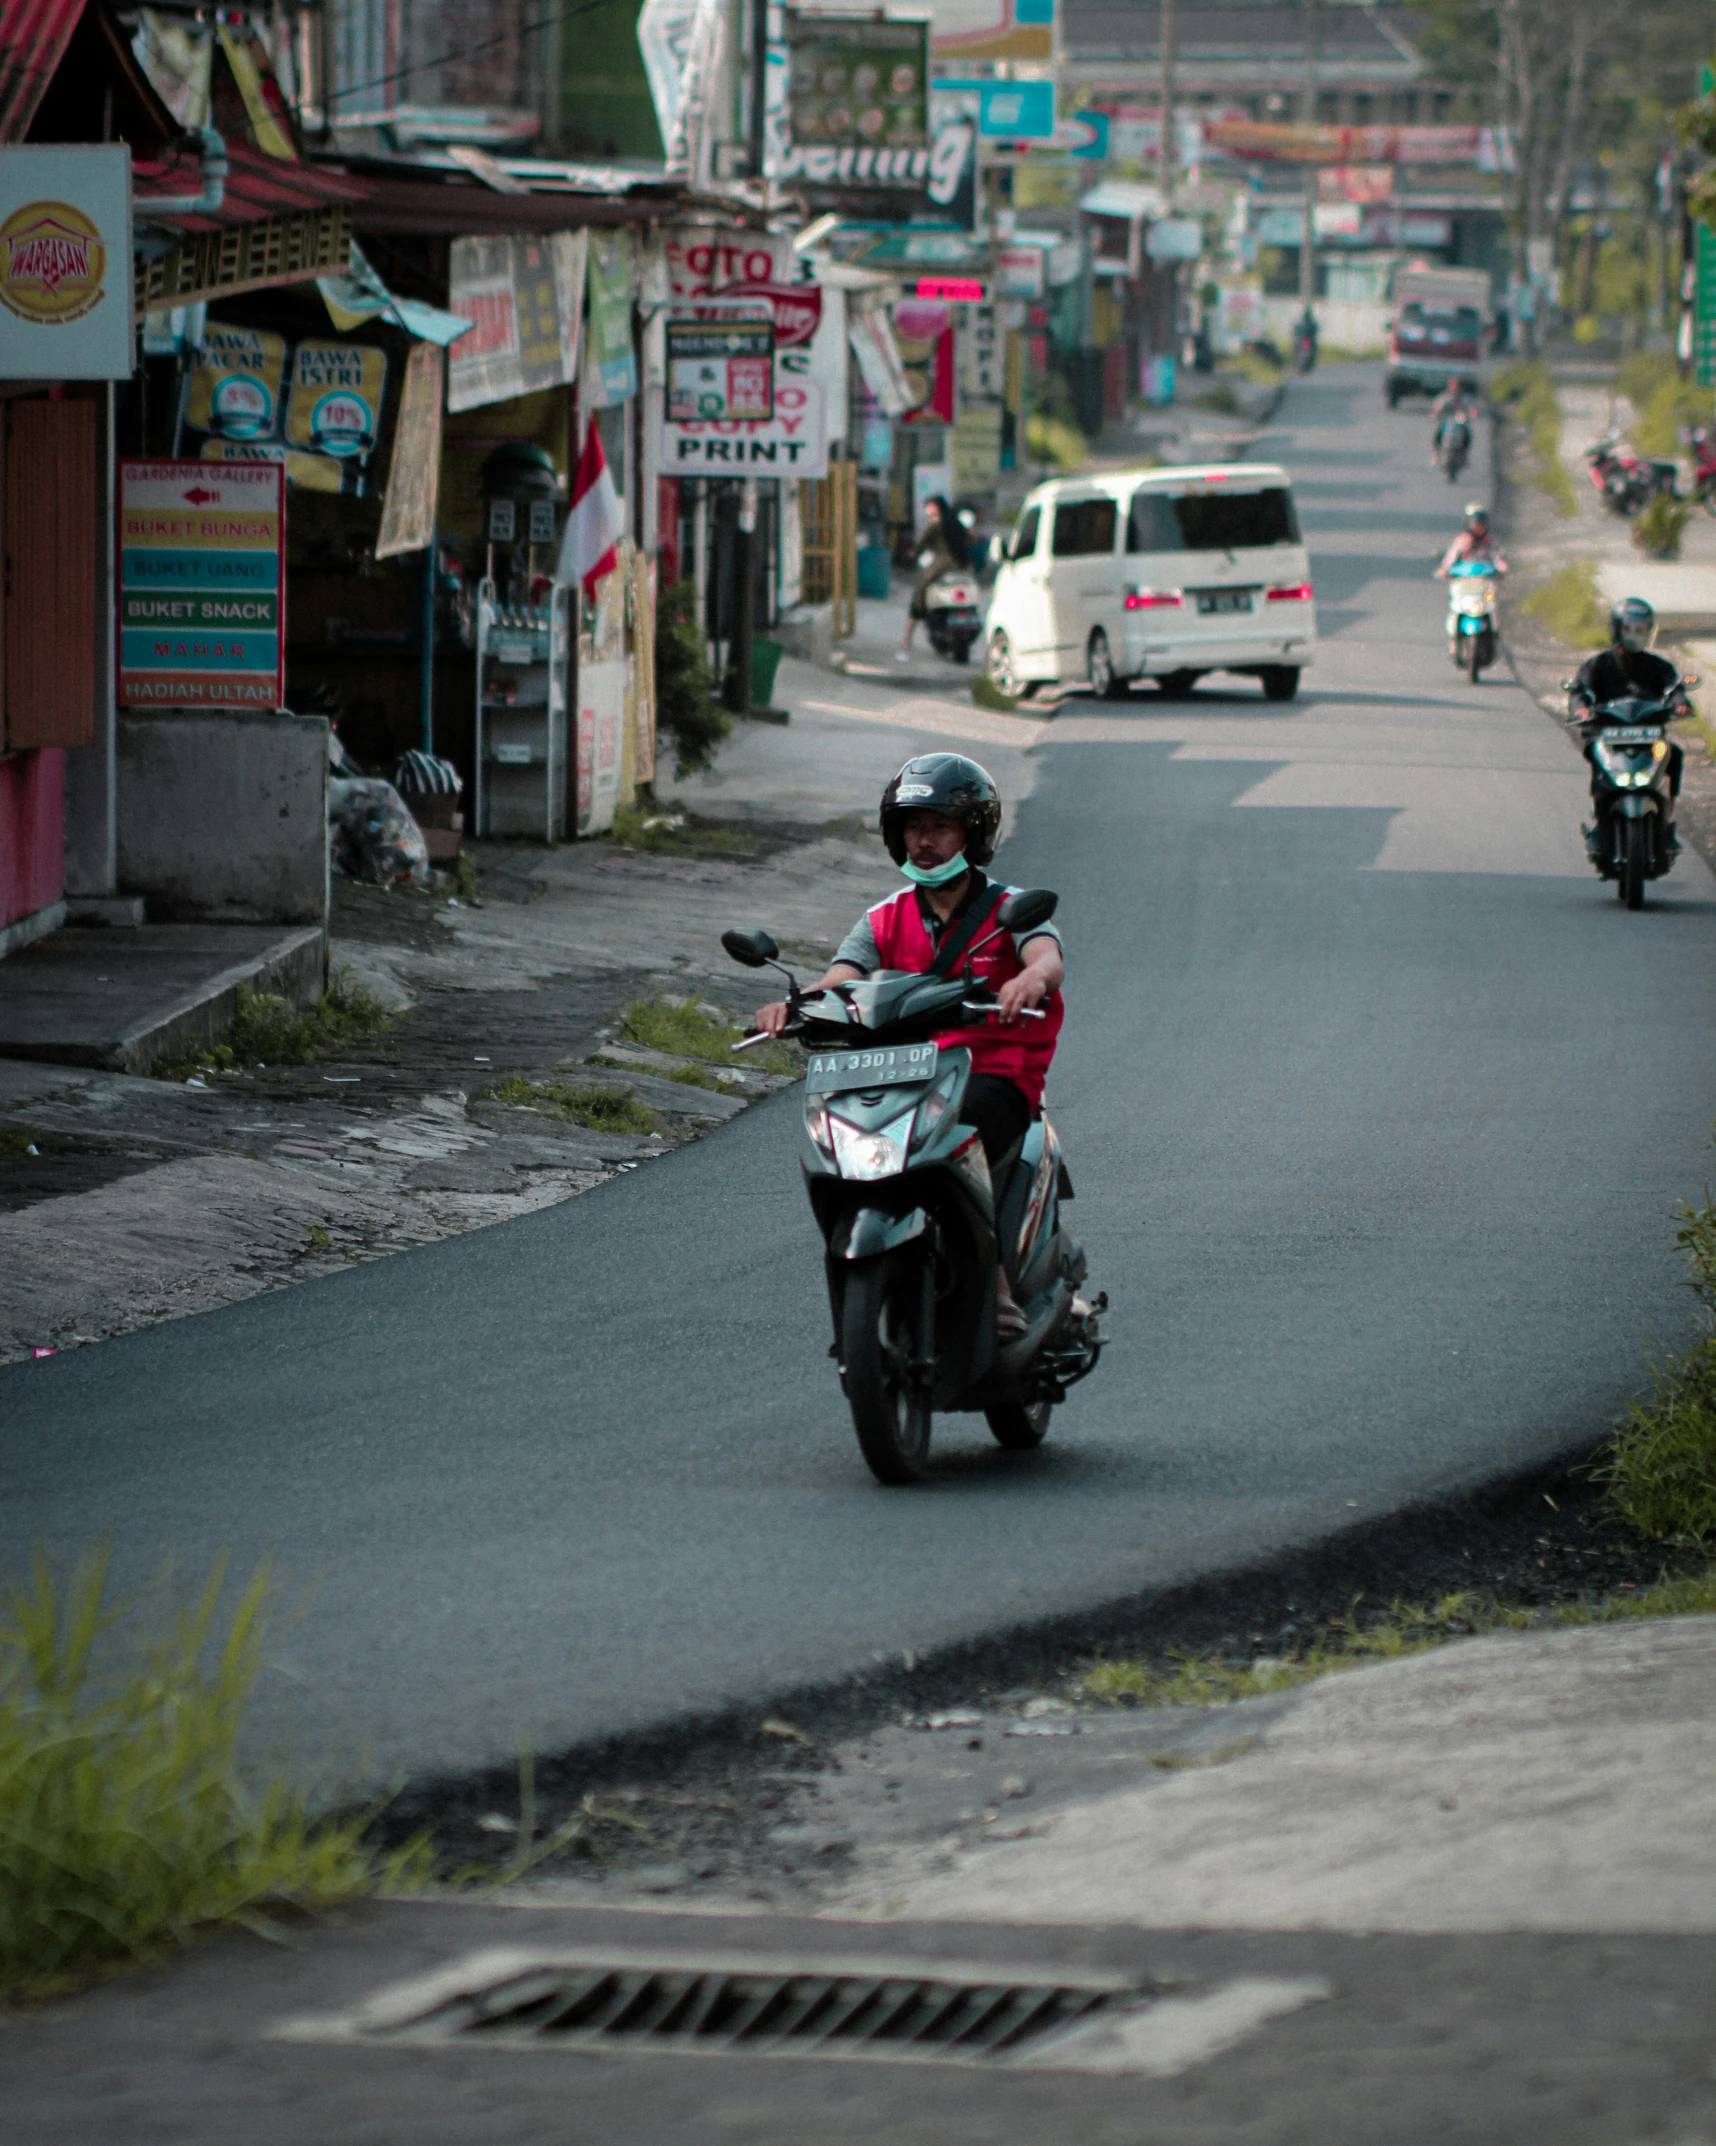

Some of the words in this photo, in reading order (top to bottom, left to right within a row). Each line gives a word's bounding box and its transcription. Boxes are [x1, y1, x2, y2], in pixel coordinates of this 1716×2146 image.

[10, 239, 88, 277] WARGASAN
[300, 350, 362, 367] BAWA
[301, 368, 362, 385] ISTRI
[325, 405, 361, 427] 10%
[677, 438, 807, 462] PRINT
[125, 467, 204, 482] GARDENIA
[209, 469, 273, 484] GALLERY
[127, 519, 194, 536] BUKET
[201, 521, 271, 537] BUNGA
[134, 560, 200, 577] BUKET
[208, 562, 264, 578] UANG
[127, 600, 196, 618] BUKET
[201, 602, 271, 619] SNACK
[154, 641, 245, 659] MAHAR
[125, 682, 204, 698] HADIAH
[209, 684, 273, 701] ULTAH
[812, 1058, 838, 1074] AA
[848, 1051, 896, 1071] 3301
